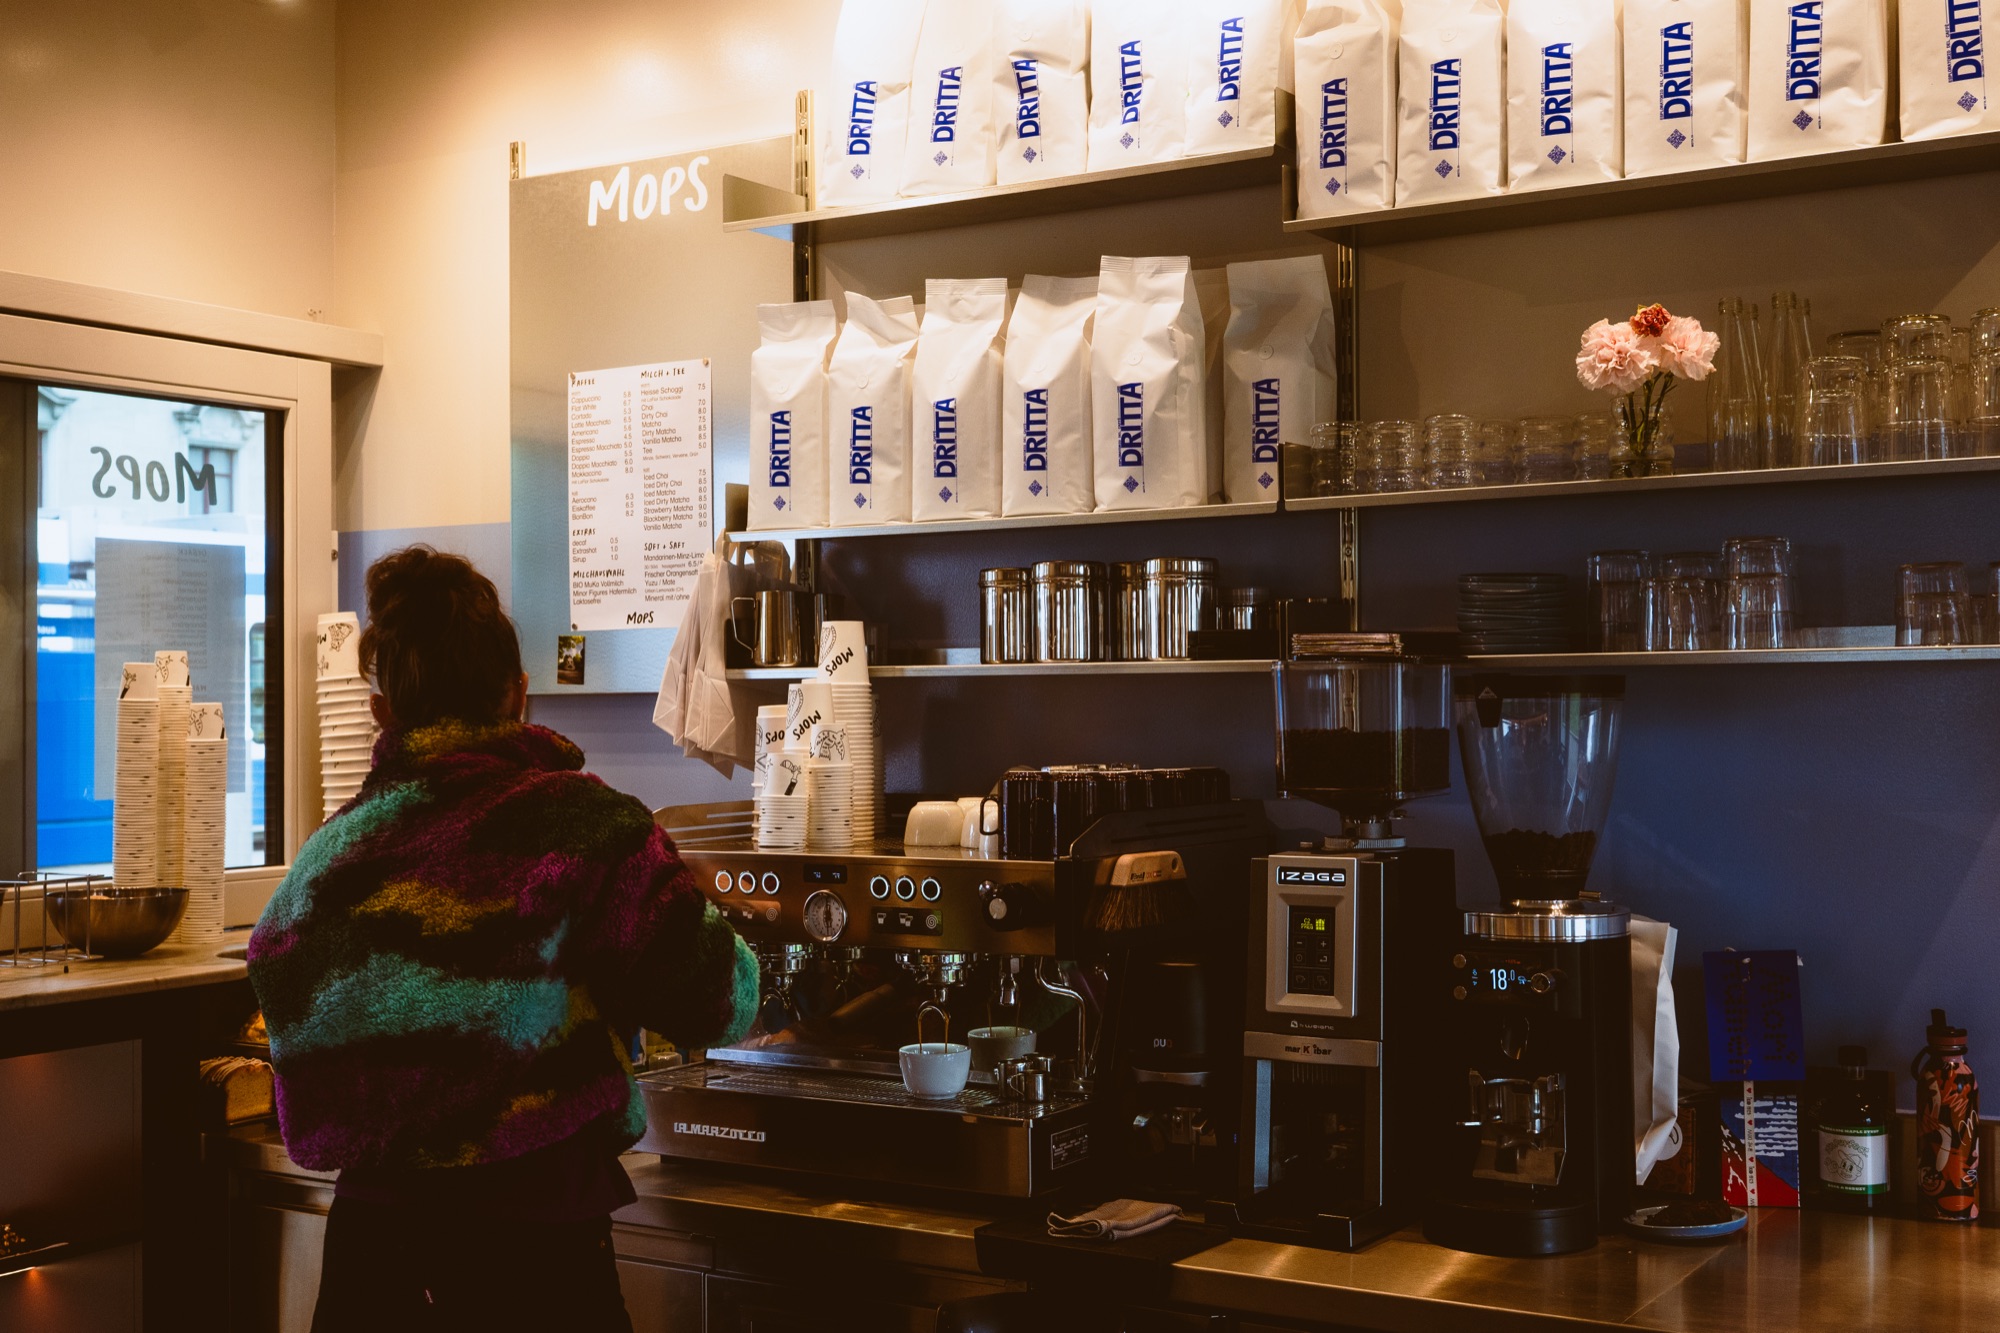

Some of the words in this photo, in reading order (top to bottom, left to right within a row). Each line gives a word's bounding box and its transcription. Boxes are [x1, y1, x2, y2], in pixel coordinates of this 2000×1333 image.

[1949, 0, 1983, 82] DRITT
[1790, 1, 1821, 100] DRITTA
[1218, 17, 1244, 101] DRITTA
[1664, 22, 1691, 119] DRITTA
[1120, 40, 1142, 124] DRITTA
[1545, 43, 1571, 136] DRITTA
[933, 66, 962, 142] DRITTA
[1014, 59, 1040, 139] DRITTA
[1433, 59, 1459, 150] DRITTA
[849, 81, 877, 155] DRITTA
[1323, 78, 1346, 169] DRITTA
[587, 155, 710, 226] MOPS
[641, 369, 663, 379] MILCH
[673, 367, 685, 376] TEE
[660, 385, 684, 394] Schoggi
[571, 395, 601, 404] Cappuccino
[623, 399, 631, 407] 6.7
[641, 404, 653, 412] Chai
[571, 421, 584, 429] Latte
[585, 419, 611, 427] Macchiato
[623, 416, 632, 424] 6.5
[641, 413, 654, 421] Dirty
[1255, 379, 1278, 463] DRITTA
[1026, 389, 1047, 471] DRITTA
[1120, 383, 1142, 467] DRITTA
[571, 429, 599, 437] Americano
[642, 429, 654, 437] Dirty
[655, 427, 676, 435] Matcha
[936, 398, 956, 477] DRITTA
[571, 438, 596, 446] Espresso
[642, 437, 661, 445] Vanilla
[852, 406, 872, 484] DRITTA
[571, 446, 596, 454] Espresso
[597, 442, 623, 451] Macchiato
[771, 411, 790, 487] DRITTA
[571, 454, 590, 462] Doppio
[571, 462, 590, 470] Doppio
[591, 460, 618, 468] Macchiato
[571, 470, 602, 478] Mokkaccino
[625, 501, 634, 509] 6.5
[656, 498, 669, 506] Dirty
[670, 496, 690, 504] Matcha
[643, 506, 672, 515] Strawberry
[571, 513, 593, 521] BonBon
[643, 514, 672, 523] Blackberry
[643, 523, 661, 531] Vanilla
[662, 522, 682, 530] Matcha
[698, 520, 707, 528] 9.0
[572, 528, 596, 537] EXTRAS
[644, 542, 660, 551] SOFT
[669, 541, 685, 549] SAFT
[572, 568, 625, 578] MILCHAUSWAHL
[665, 569, 699, 578] Orangensaft
[573, 581, 583, 589] BIO
[588, 588, 608, 597] Figures
[609, 587, 637, 595] Hafermilch
[626, 611, 654, 625] MOPS
[825, 647, 854, 676] MOPS
[793, 710, 822, 741] MOPS
[766, 730, 785, 745] OPS
[1722, 959, 1752, 1075] Ramen
[1760, 967, 1799, 1064] Mori
[690, 1123, 765, 1142] MARZOCCO
